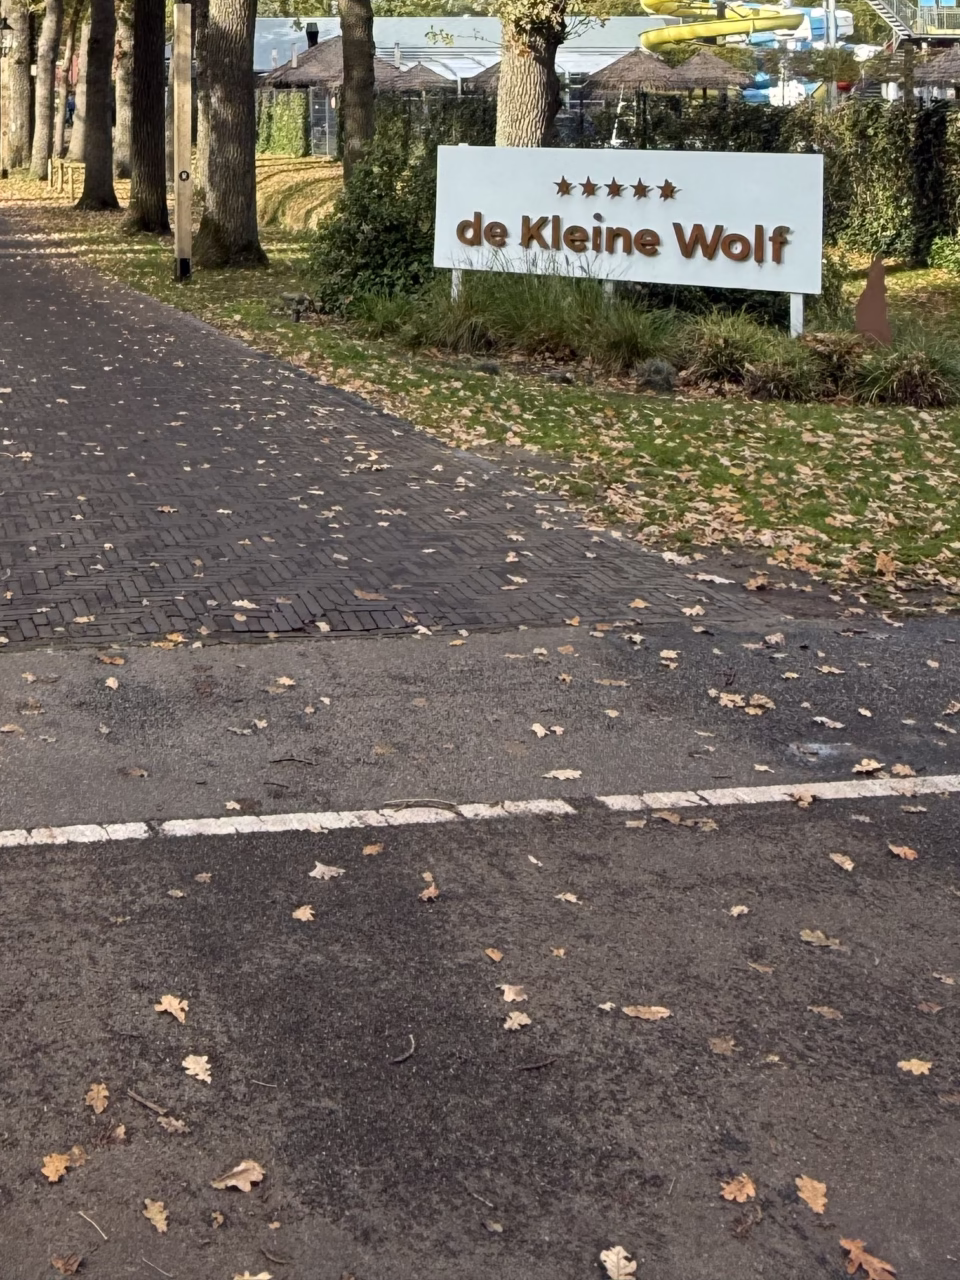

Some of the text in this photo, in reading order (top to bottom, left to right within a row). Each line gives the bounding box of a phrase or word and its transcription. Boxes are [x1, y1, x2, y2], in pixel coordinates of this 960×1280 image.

[456, 211, 791, 264] de Kleine Wolf
